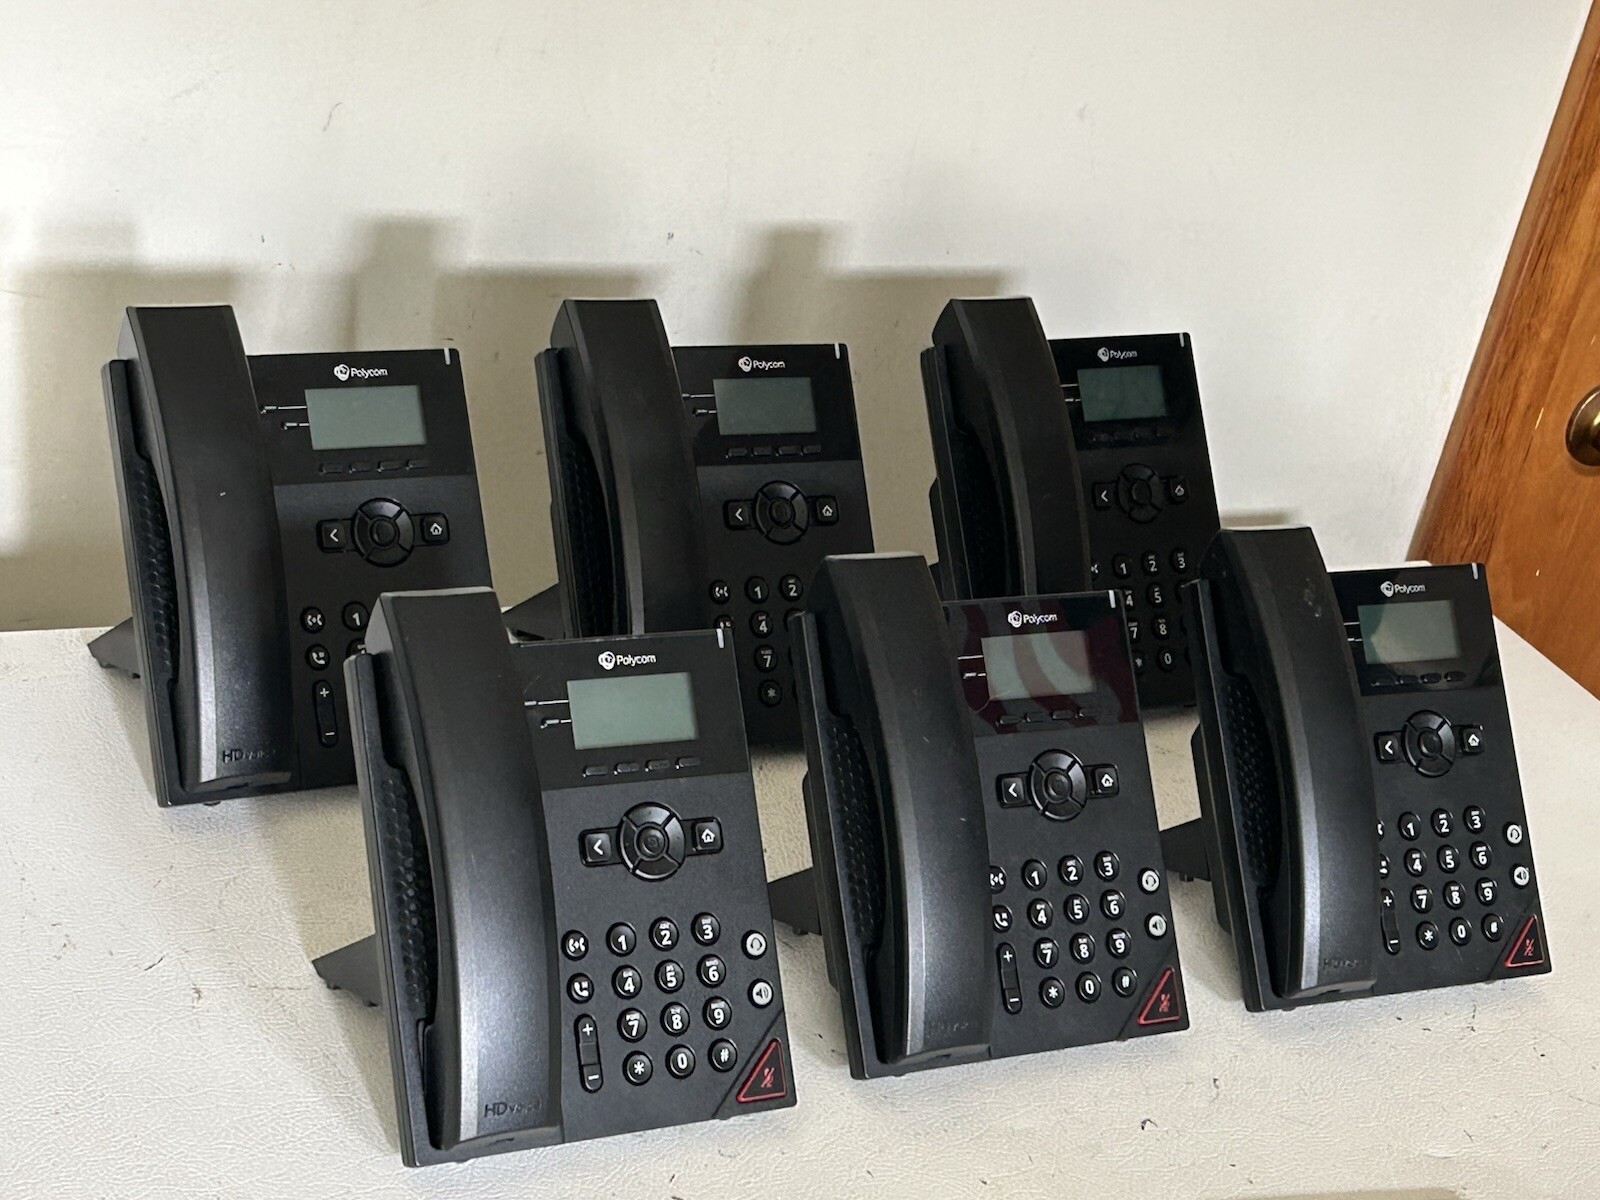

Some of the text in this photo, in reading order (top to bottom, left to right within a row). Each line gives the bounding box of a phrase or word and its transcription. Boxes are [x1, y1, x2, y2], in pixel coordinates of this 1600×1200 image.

[1110, 350, 1137, 359] Polycom
[752, 360, 786, 370] Polycom
[351, 368, 388, 378] Polycom
[1120, 558, 1185, 574] 1 2 3
[755, 585, 797, 598] 1 2
[1395, 584, 1426, 594] Polycom
[1154, 592, 1162, 603] 5
[352, 613, 360, 626] 1
[759, 621, 767, 632] 4
[1024, 613, 1058, 626] Polycom
[1130, 624, 1167, 638] 7 8
[617, 654, 656, 666] Polycom
[763, 656, 771, 667] 7
[1407, 816, 1481, 836] 1 2 3
[1413, 852, 1487, 872] 4 5 6
[1031, 863, 1113, 885] 1 2 3
[1418, 888, 1492, 908] 7 8 9
[1037, 902, 1119, 924] 4 5 6
[618, 926, 713, 950] 1 2 3
[1457, 925, 1466, 938] 0
[1043, 940, 1124, 963] 7 8 9
[624, 967, 719, 992] 4 5 6
[1085, 980, 1094, 994] 0
[629, 1009, 723, 1036] 7 8 9
[678, 1054, 687, 1069] 0
